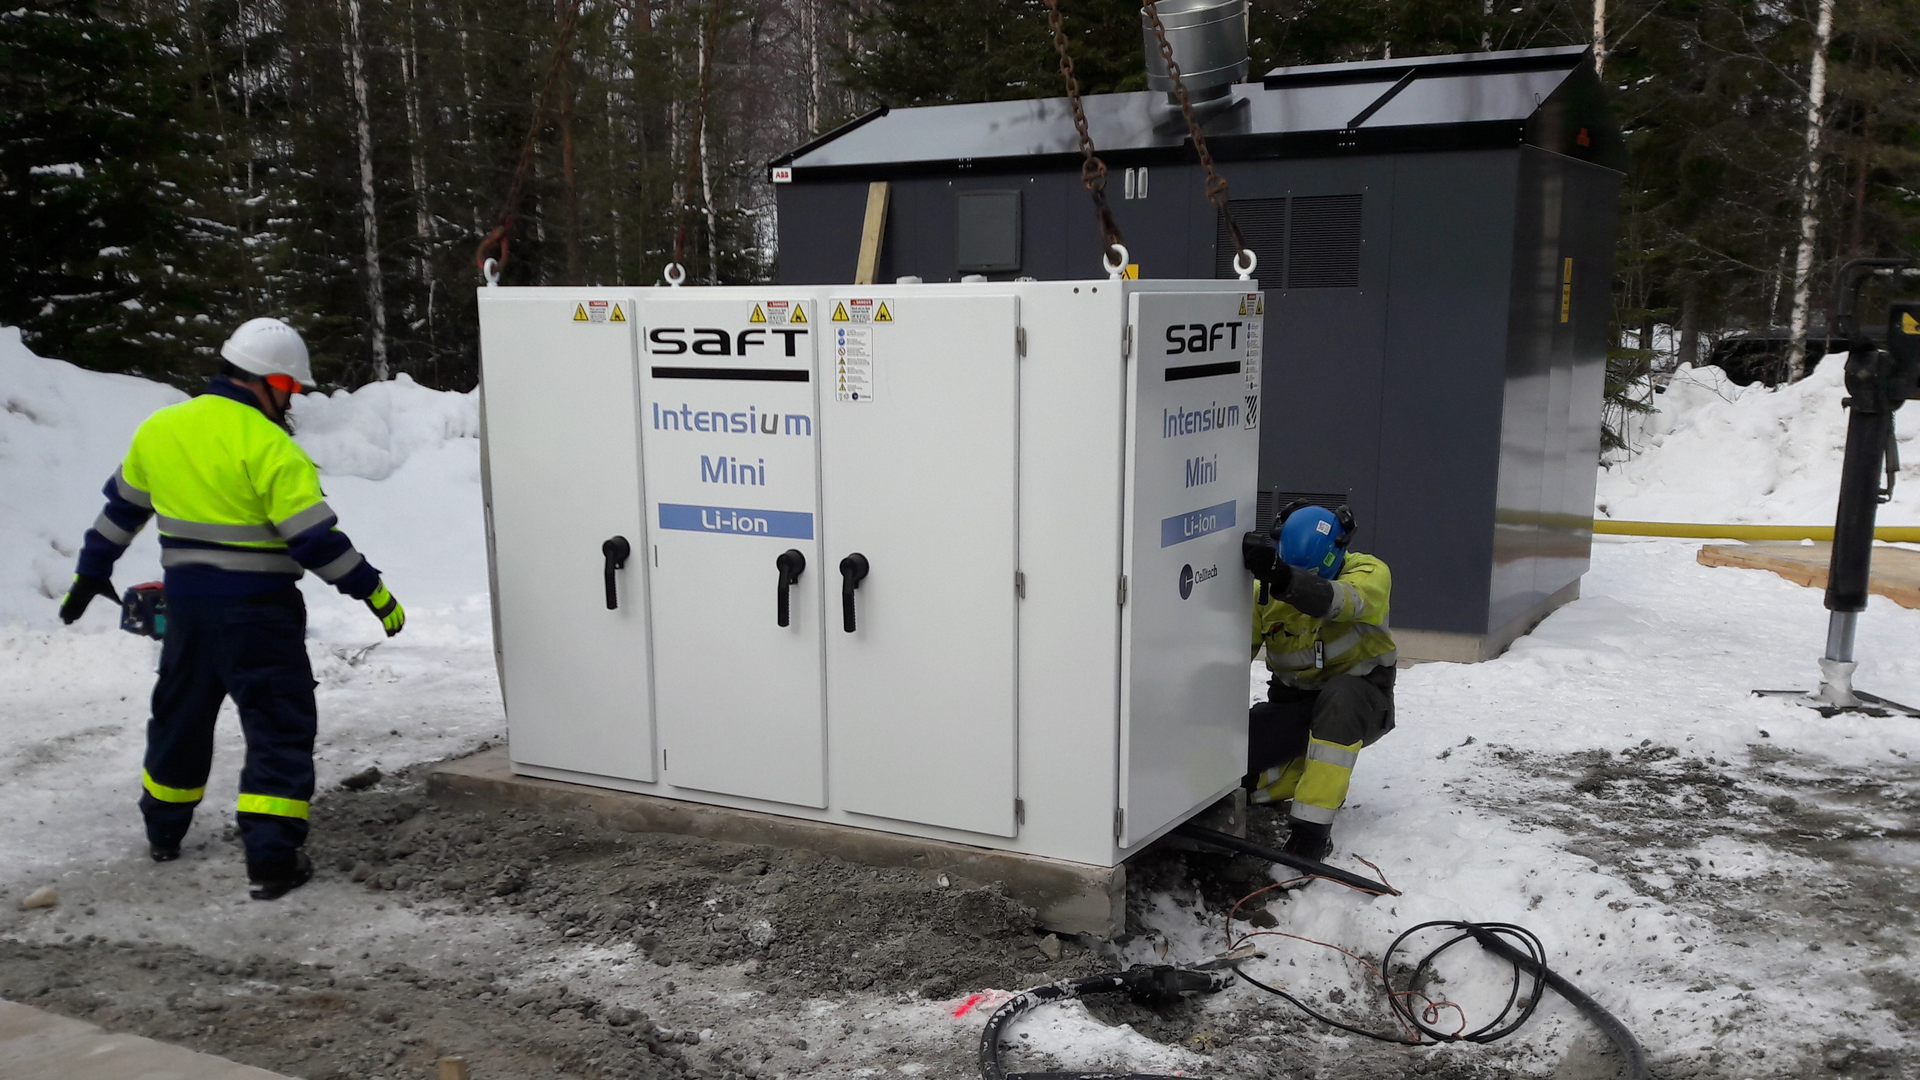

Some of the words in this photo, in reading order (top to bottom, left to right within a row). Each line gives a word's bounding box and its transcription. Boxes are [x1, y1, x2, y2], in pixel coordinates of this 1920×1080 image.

[652, 402, 812, 436] Intensium
[1163, 401, 1240, 439] Intensium
[701, 455, 766, 486] Mini
[1185, 453, 1218, 488] Mini
[701, 510, 768, 533] Li-ion
[1184, 513, 1216, 538] Li-ion
